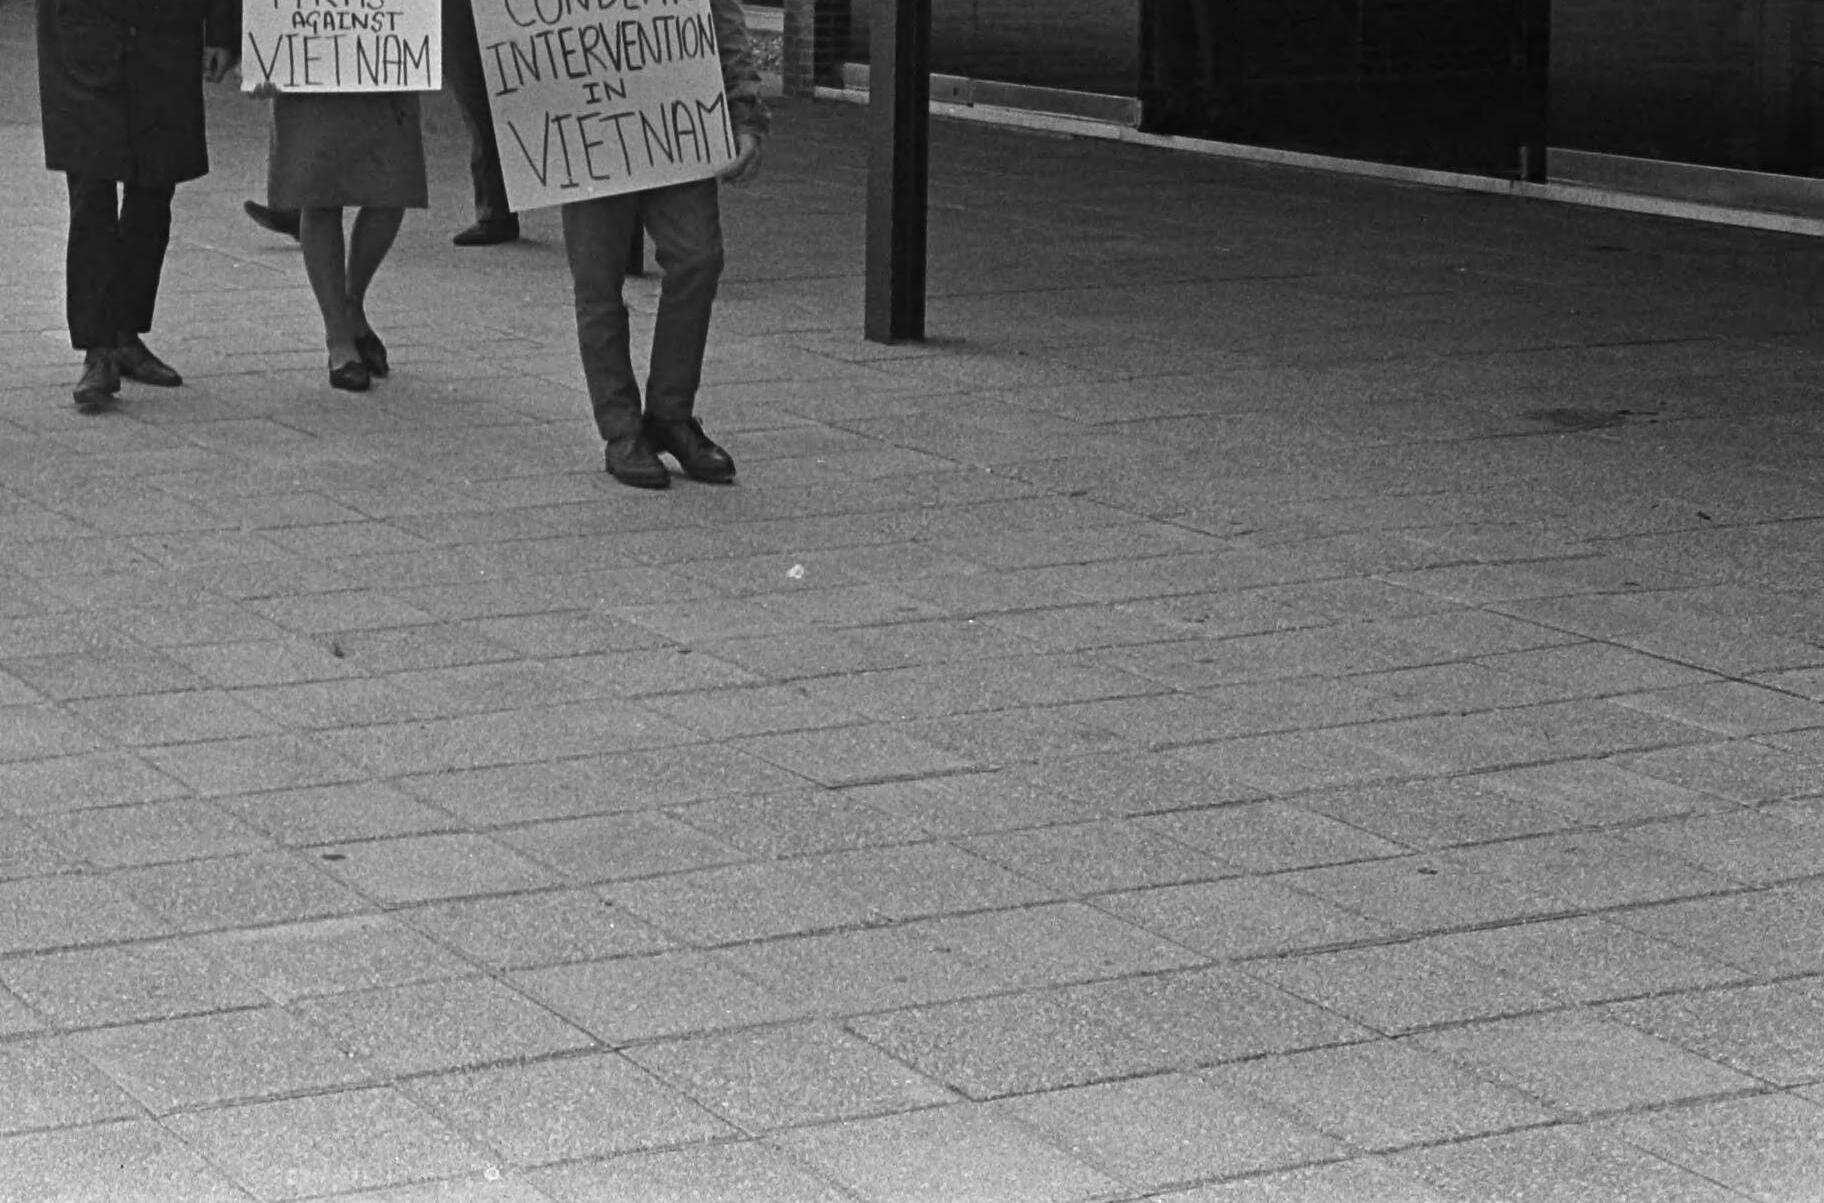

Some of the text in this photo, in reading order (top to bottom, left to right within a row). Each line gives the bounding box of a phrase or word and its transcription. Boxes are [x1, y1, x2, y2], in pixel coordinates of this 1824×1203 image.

[292, 10, 404, 34] AGAINST
[249, 31, 431, 87] VIETNAM
[487, 13, 716, 96] INTERVENTION
[582, 77, 626, 105] IN
[507, 91, 733, 189] VIETNAM
